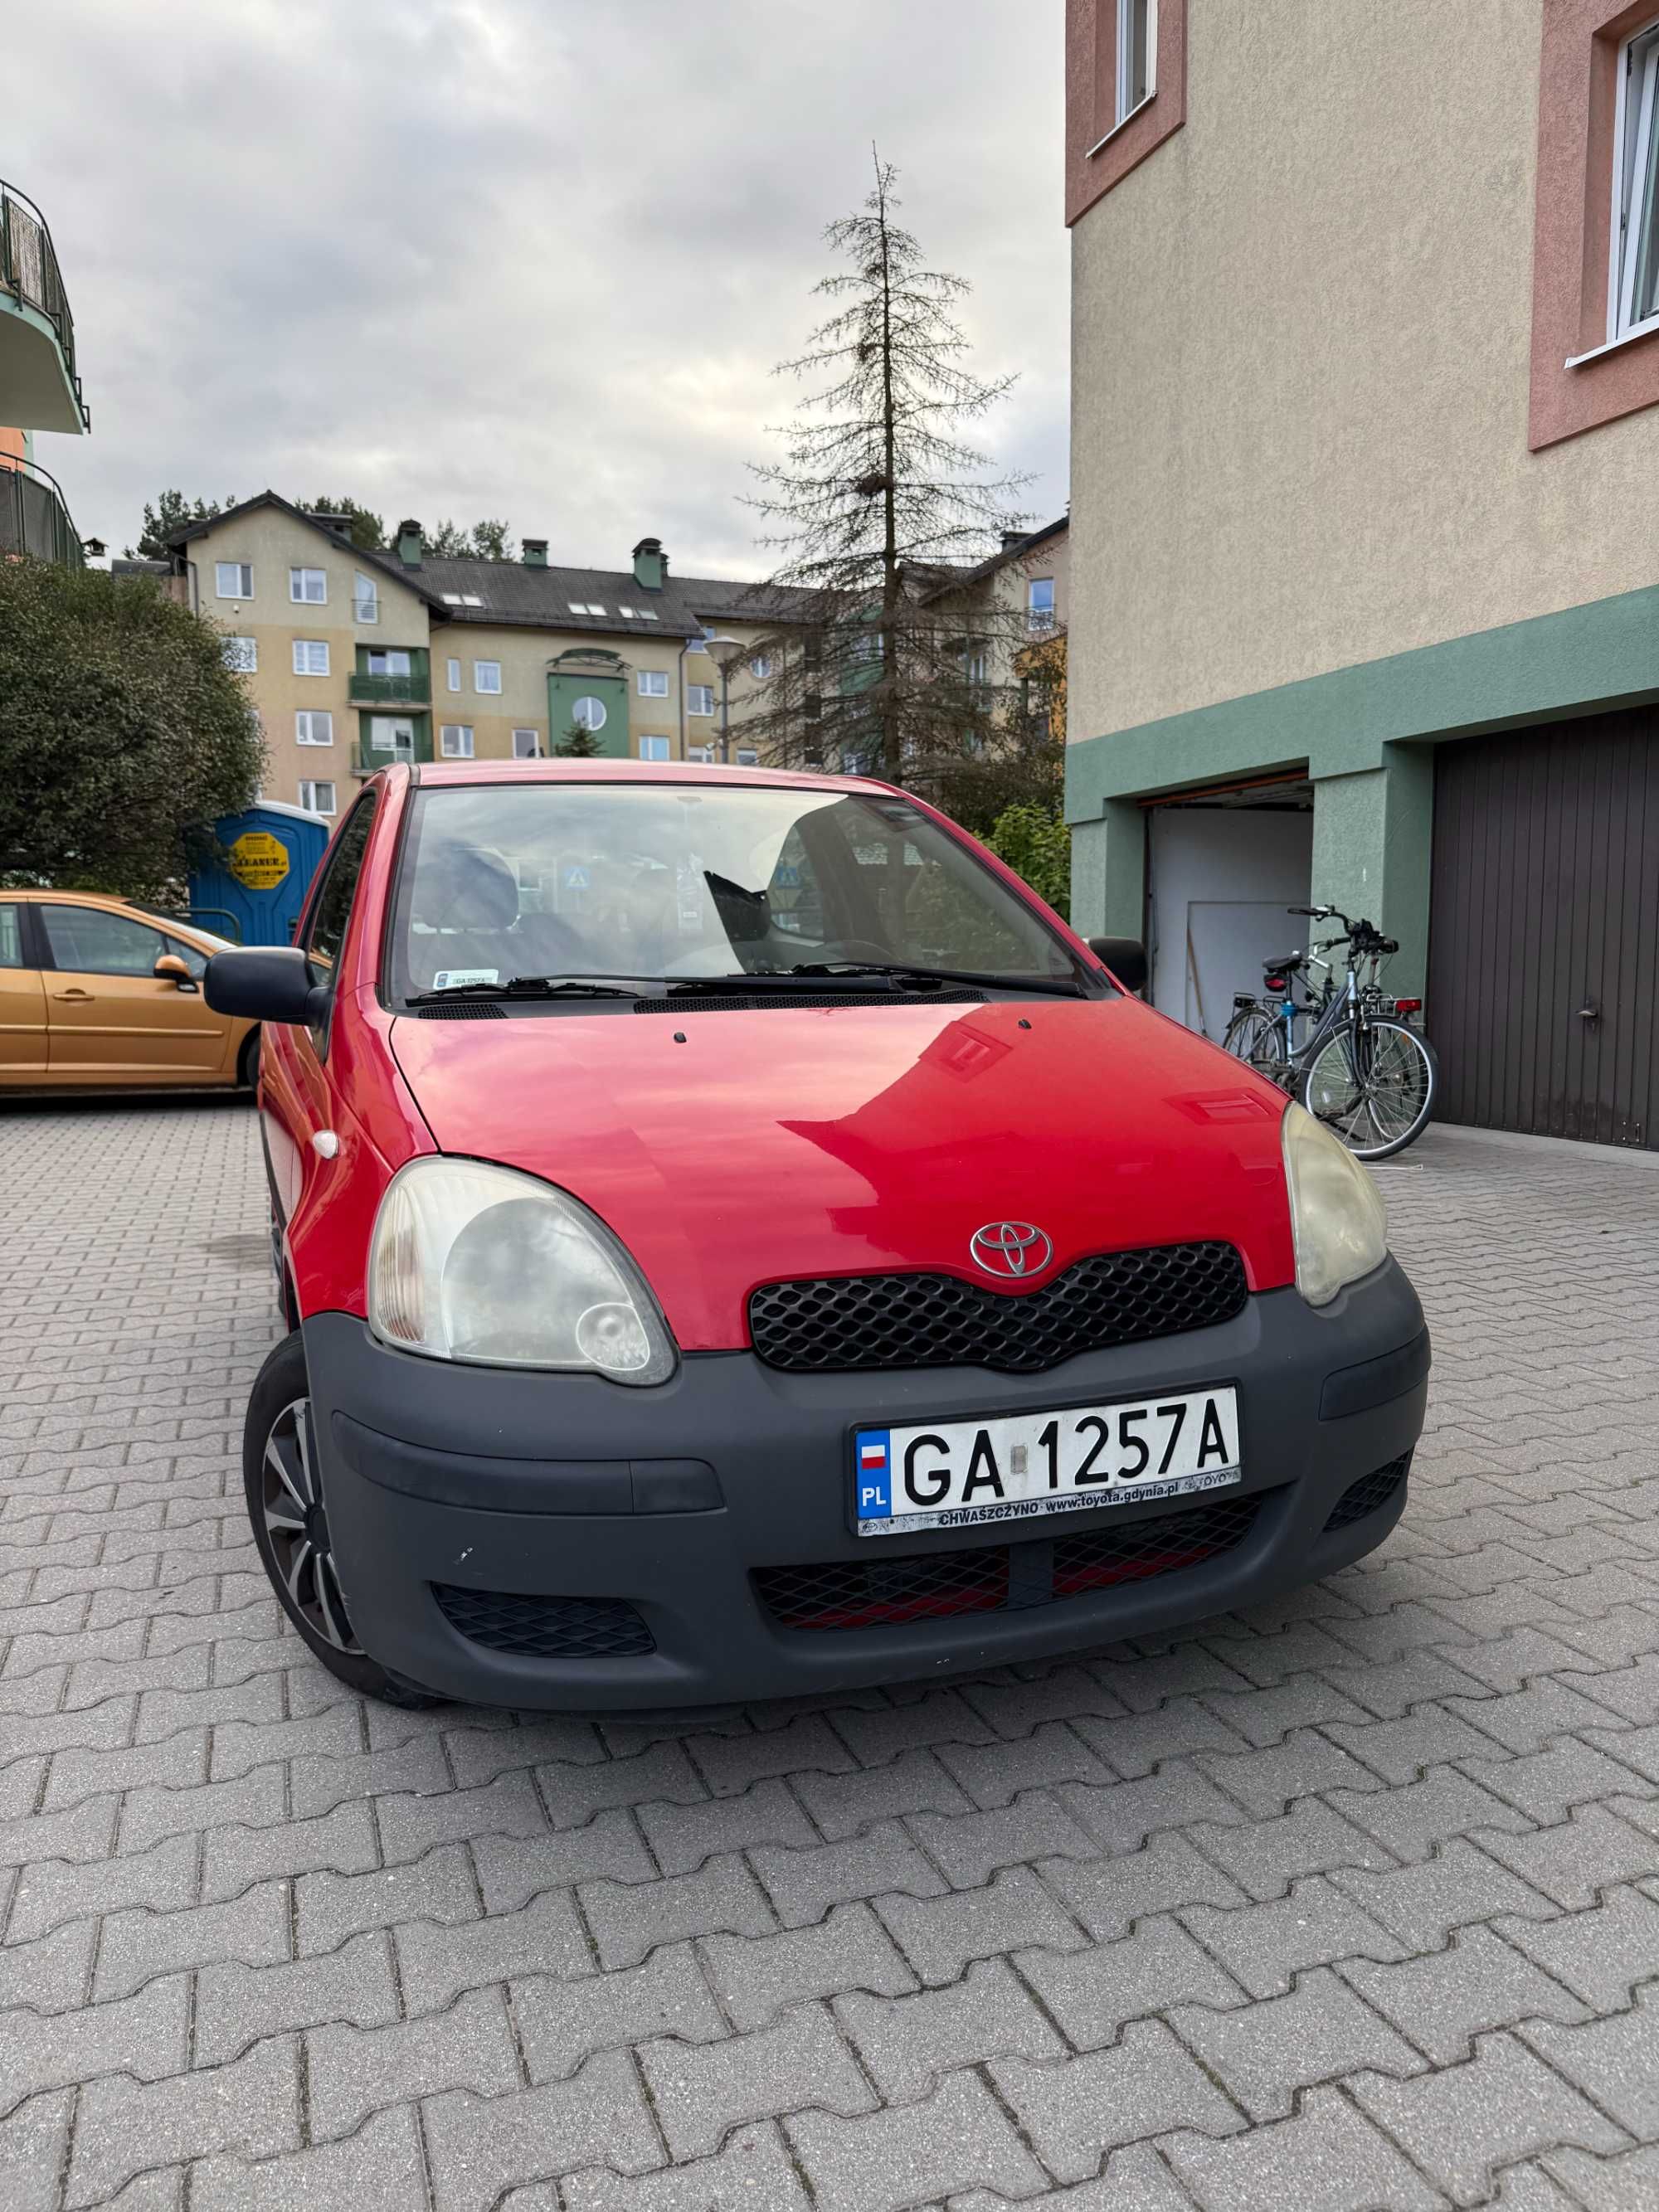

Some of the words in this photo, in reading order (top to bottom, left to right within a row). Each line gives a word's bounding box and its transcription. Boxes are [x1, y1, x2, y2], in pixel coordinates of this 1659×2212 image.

[903, 1429, 1005, 1506] GA
[1037, 1398, 1229, 1490] 1257A
[861, 1487, 887, 1507] PL
[1045, 1482, 1179, 1512] www.toyota.gdynia.pl
